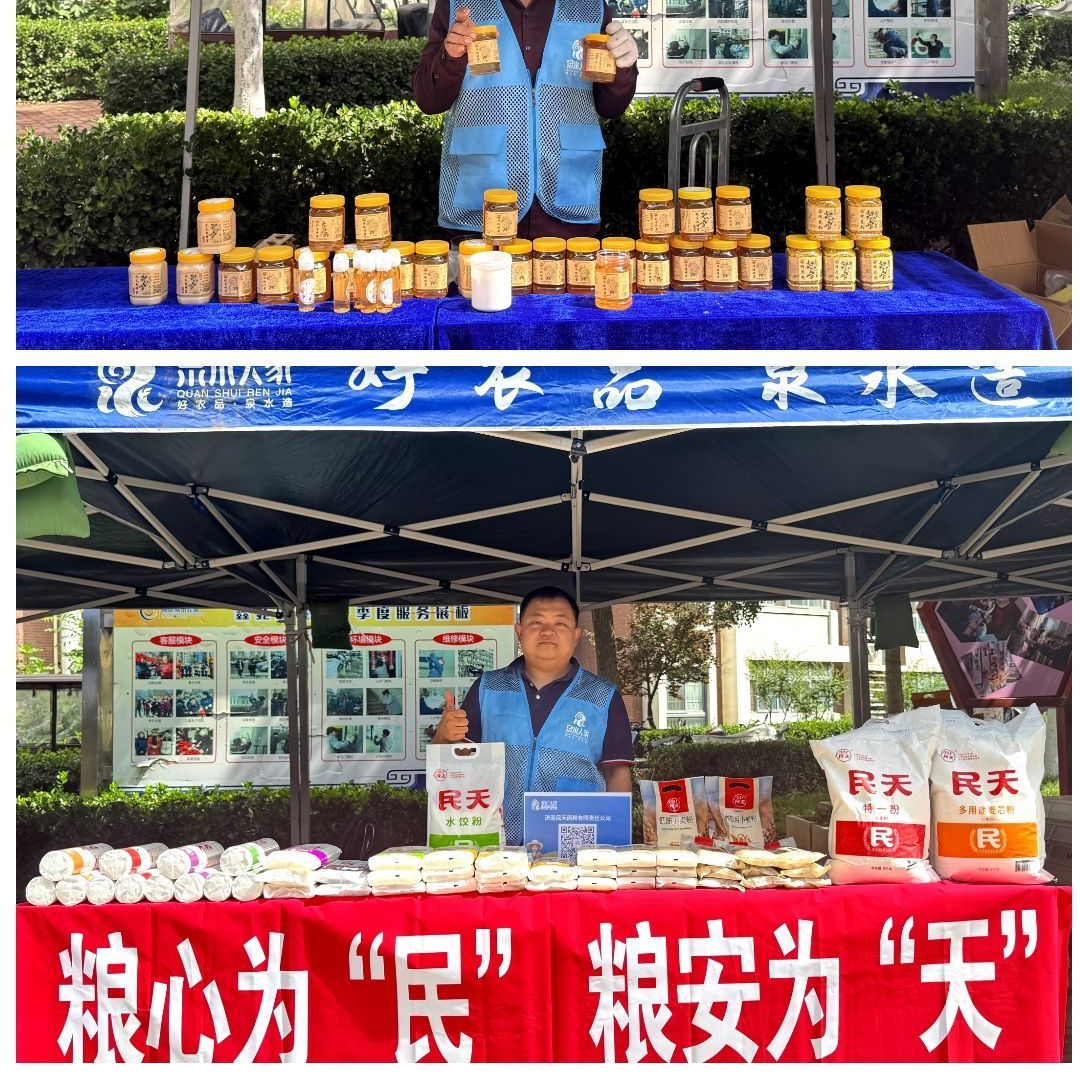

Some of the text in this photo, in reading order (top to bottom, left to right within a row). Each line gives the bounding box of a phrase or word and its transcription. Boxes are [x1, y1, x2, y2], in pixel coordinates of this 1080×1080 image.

[176, 388, 292, 398] QUAN SHUI REN JIA
[356, 606, 470, 620] 季度服务展板
[159, 635, 193, 646] 客服模块
[253, 634, 287, 645] 安全模块
[351, 633, 383, 645] 环境模块
[442, 633, 475, 644] 维修模块
[848, 770, 912, 797] 民天
[952, 770, 1019, 796] 民天
[438, 789, 490, 810] 民天
[863, 803, 900, 815] 特一粉
[958, 805, 1015, 816] 多用途麦芯粉
[445, 816, 482, 827] 水饺粉
[870, 826, 895, 848] 民
[977, 827, 1001, 849] 民
